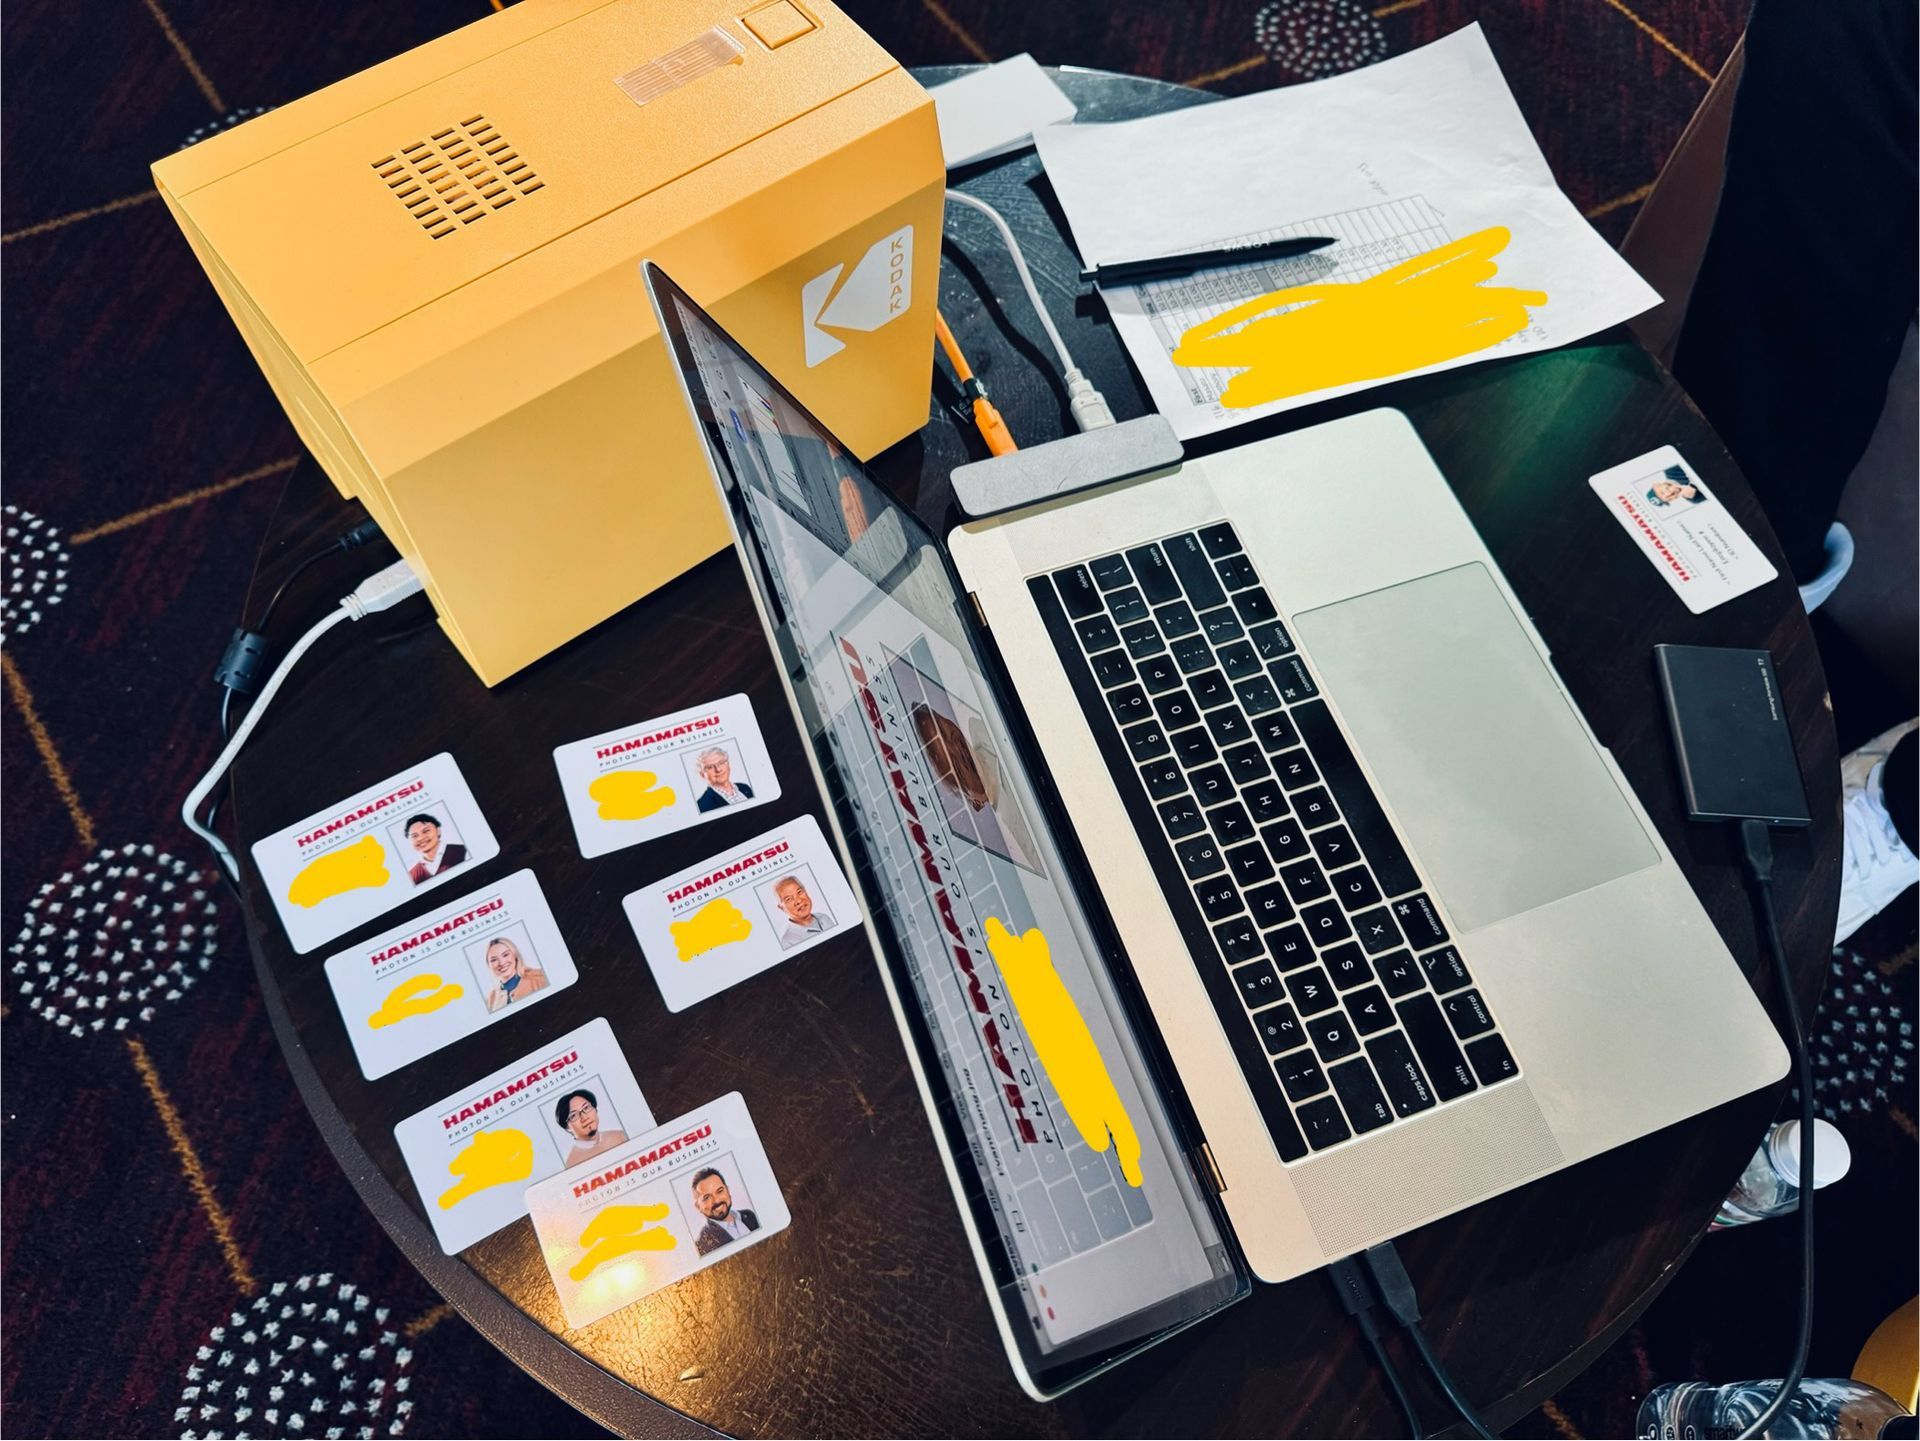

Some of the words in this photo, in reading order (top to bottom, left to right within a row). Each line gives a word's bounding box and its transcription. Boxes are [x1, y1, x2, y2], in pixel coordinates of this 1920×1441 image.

[890, 236, 904, 314] KODAK
[1617, 495, 1690, 582] HAMAMATSU
[1185, 537, 1196, 552] shift
[1150, 547, 1162, 567] return
[1077, 569, 1089, 589] delete
[1274, 627, 1289, 648] option
[1154, 670, 1166, 679] P
[1290, 659, 1312, 692] command
[1206, 684, 1216, 693] L
[1130, 697, 1142, 706] 0
[1172, 706, 1181, 714] O
[1223, 721, 1233, 729] K
[865, 655, 929, 808] BUSINESS
[1270, 726, 1281, 736] M
[596, 716, 720, 759] HAMAMATSU
[1147, 734, 1159, 743] 9
[599, 753, 637, 767] PHOTON
[657, 742, 674, 751] OUR
[680, 727, 724, 744] BUSINESS
[1290, 764, 1300, 773] N
[1165, 771, 1176, 780] 8
[1207, 780, 1217, 789] U
[1260, 796, 1271, 805] H
[1310, 803, 1320, 811] B
[297, 780, 424, 848] HAMAMATSU
[1182, 810, 1195, 819] 7
[302, 835, 340, 855] PHOTON
[360, 816, 379, 827] OUR
[384, 792, 430, 816] BUSINESS
[1224, 820, 1236, 829] Y
[1280, 836, 1290, 844] G
[1328, 843, 1340, 852] V
[1202, 850, 1211, 858] 6
[932, 833, 961, 898] OUR
[1243, 860, 1255, 869] T
[667, 841, 789, 903] HAMAMATSU
[672, 892, 710, 912] PHOTON
[728, 875, 746, 886] OUR
[751, 853, 794, 876] BUSINESS
[1299, 877, 1312, 885] F
[839, 636, 1038, 1143] HAMAMATSU
[1351, 883, 1361, 891] C
[1221, 891, 1231, 899] 5
[1265, 900, 1276, 909] R
[1417, 898, 1441, 936] command
[1321, 918, 1332, 927] D
[371, 898, 504, 966] HAMAMATSU
[1372, 925, 1383, 934] X
[967, 927, 982, 955] IS
[1239, 932, 1250, 941] 4
[375, 954, 416, 974] PHOTON
[436, 935, 456, 947] OUR
[461, 910, 509, 935] BUSINESS
[1285, 943, 1296, 951] E
[1342, 961, 1353, 969] S
[1446, 951, 1463, 977] option
[1394, 968, 1405, 977] Z
[1261, 976, 1271, 985] 3
[1305, 986, 1317, 997] W
[1365, 1004, 1376, 1012] A
[1467, 995, 1487, 1024] control
[1282, 1021, 1292, 1029] 2
[1328, 1031, 1339, 1041] Q
[988, 985, 1053, 1143] PHOTON
[1502, 1059, 1511, 1071] fn
[1303, 1068, 1314, 1077] 1
[1404, 1062, 1417, 1079] lock
[1455, 1064, 1470, 1085] shift
[443, 1051, 578, 1129] HAMAMATSU
[1412, 1079, 1429, 1102] caps
[448, 1115, 490, 1139] PHOTON
[495, 1106, 505, 1115] IS
[510, 1093, 530, 1107] OUR
[536, 1064, 584, 1093] BUSINESS
[1375, 1103, 1386, 1118] tab
[573, 1125, 712, 1198] HAMAMATSU
[578, 1185, 621, 1208] PHOTON
[626, 1178, 636, 1186] IS
[642, 1166, 663, 1179] OUR
[669, 1139, 717, 1166] BUSINESS
